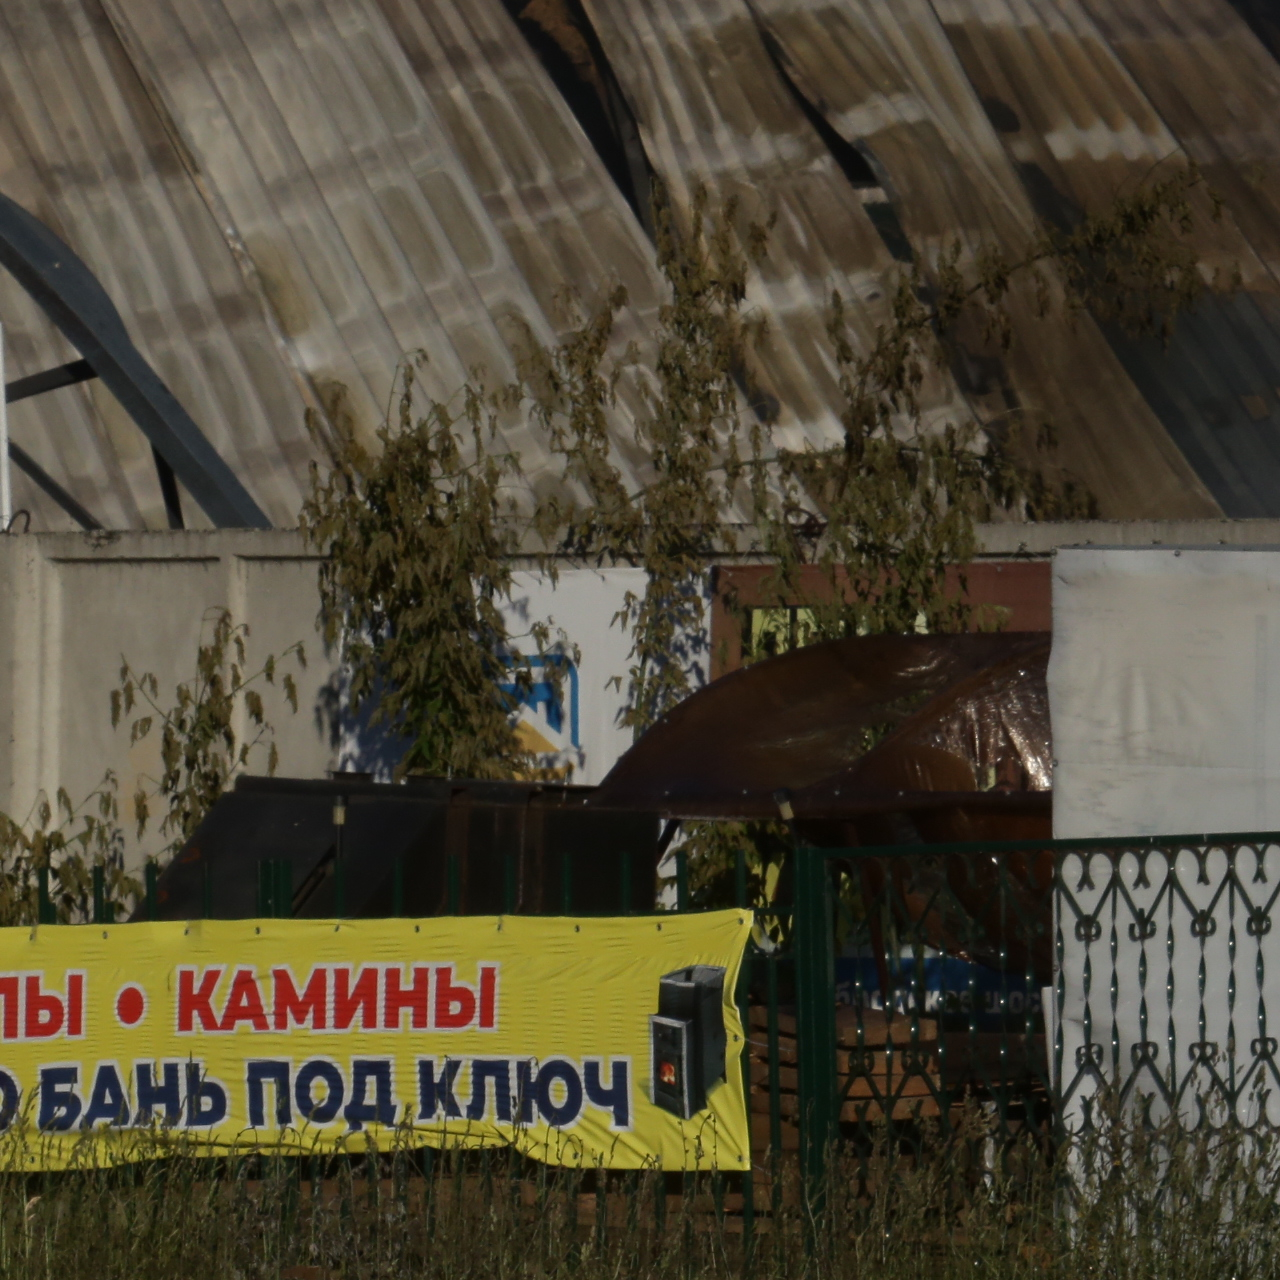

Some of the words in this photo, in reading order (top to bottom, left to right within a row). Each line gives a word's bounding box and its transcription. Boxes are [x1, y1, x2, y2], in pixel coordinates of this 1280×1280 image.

[177, 966, 497, 1032] КАМИНЫ
[38, 1061, 227, 1132] БАНЬ
[247, 1060, 396, 1131] ПОД
[418, 1059, 629, 1128] КЛЮЧ
